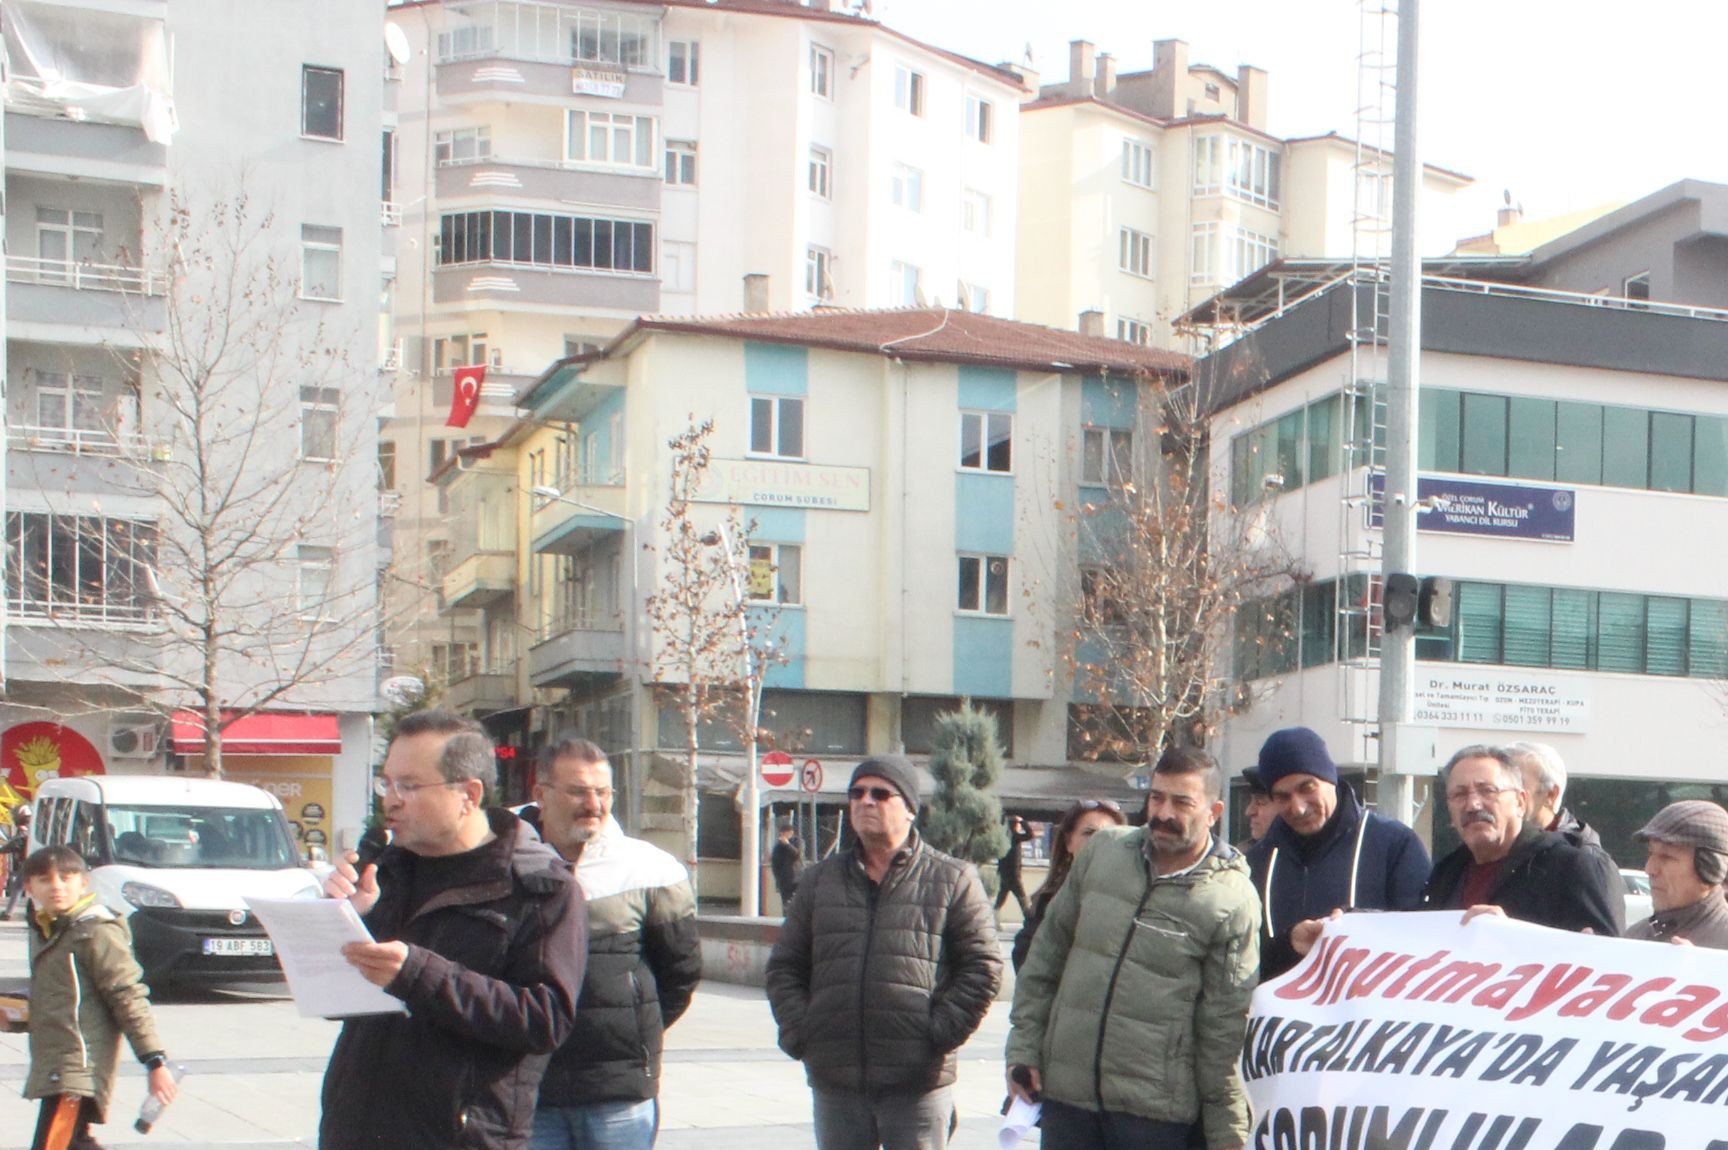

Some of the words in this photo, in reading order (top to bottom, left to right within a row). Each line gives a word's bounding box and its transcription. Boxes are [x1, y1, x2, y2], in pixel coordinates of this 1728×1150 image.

[820, 472, 860, 488] SEN
[1488, 501, 1529, 520] KÜLTÜR
[1429, 679, 1448, 689] Dr.
[1452, 680, 1490, 691] Murat
[1497, 681, 1557, 695] ÖZSARAÇ
[1417, 710, 1439, 720] 0364
[1442, 711, 1458, 720] 333
[1503, 714, 1524, 724] 0501
[1527, 715, 1542, 724] 359
[211, 940, 223, 951] 19
[1242, 1016, 1579, 1086] KARTALKAYA'DA
